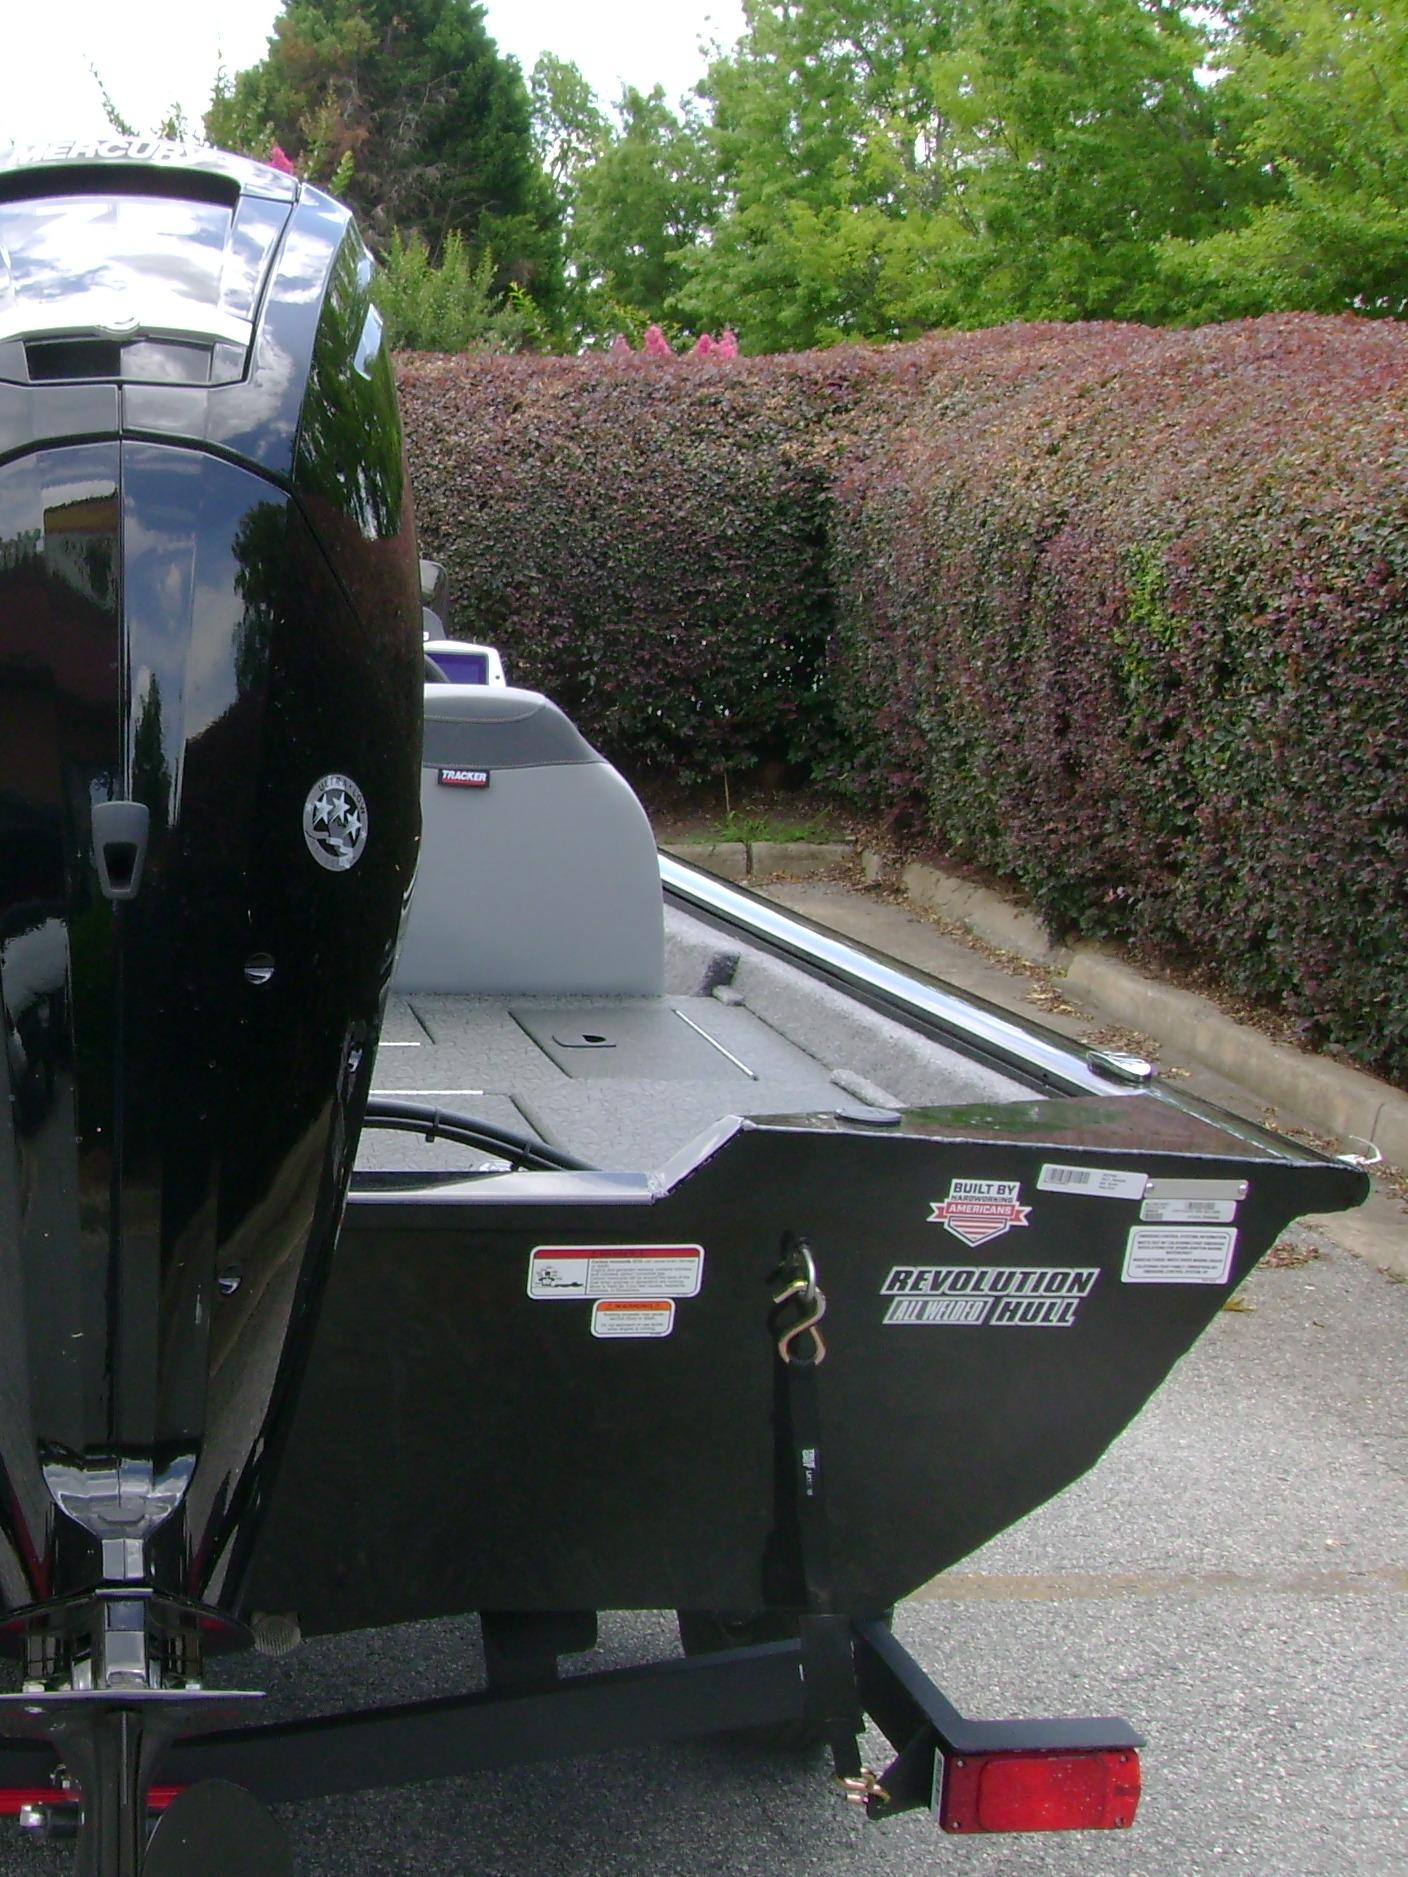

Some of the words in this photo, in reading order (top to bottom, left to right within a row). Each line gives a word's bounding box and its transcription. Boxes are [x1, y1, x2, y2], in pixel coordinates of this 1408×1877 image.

[10, 139, 210, 164] MERCURY
[442, 769, 487, 782] TRACKER
[953, 1182, 994, 1195] BUILT
[996, 1184, 1016, 1196] BY
[948, 1203, 1012, 1215] AMERICANS
[883, 1268, 1096, 1295] REVOLUTION
[893, 1300, 924, 1321] ALL
[922, 1300, 985, 1321] WELDED
[994, 1300, 1076, 1324] HULL
